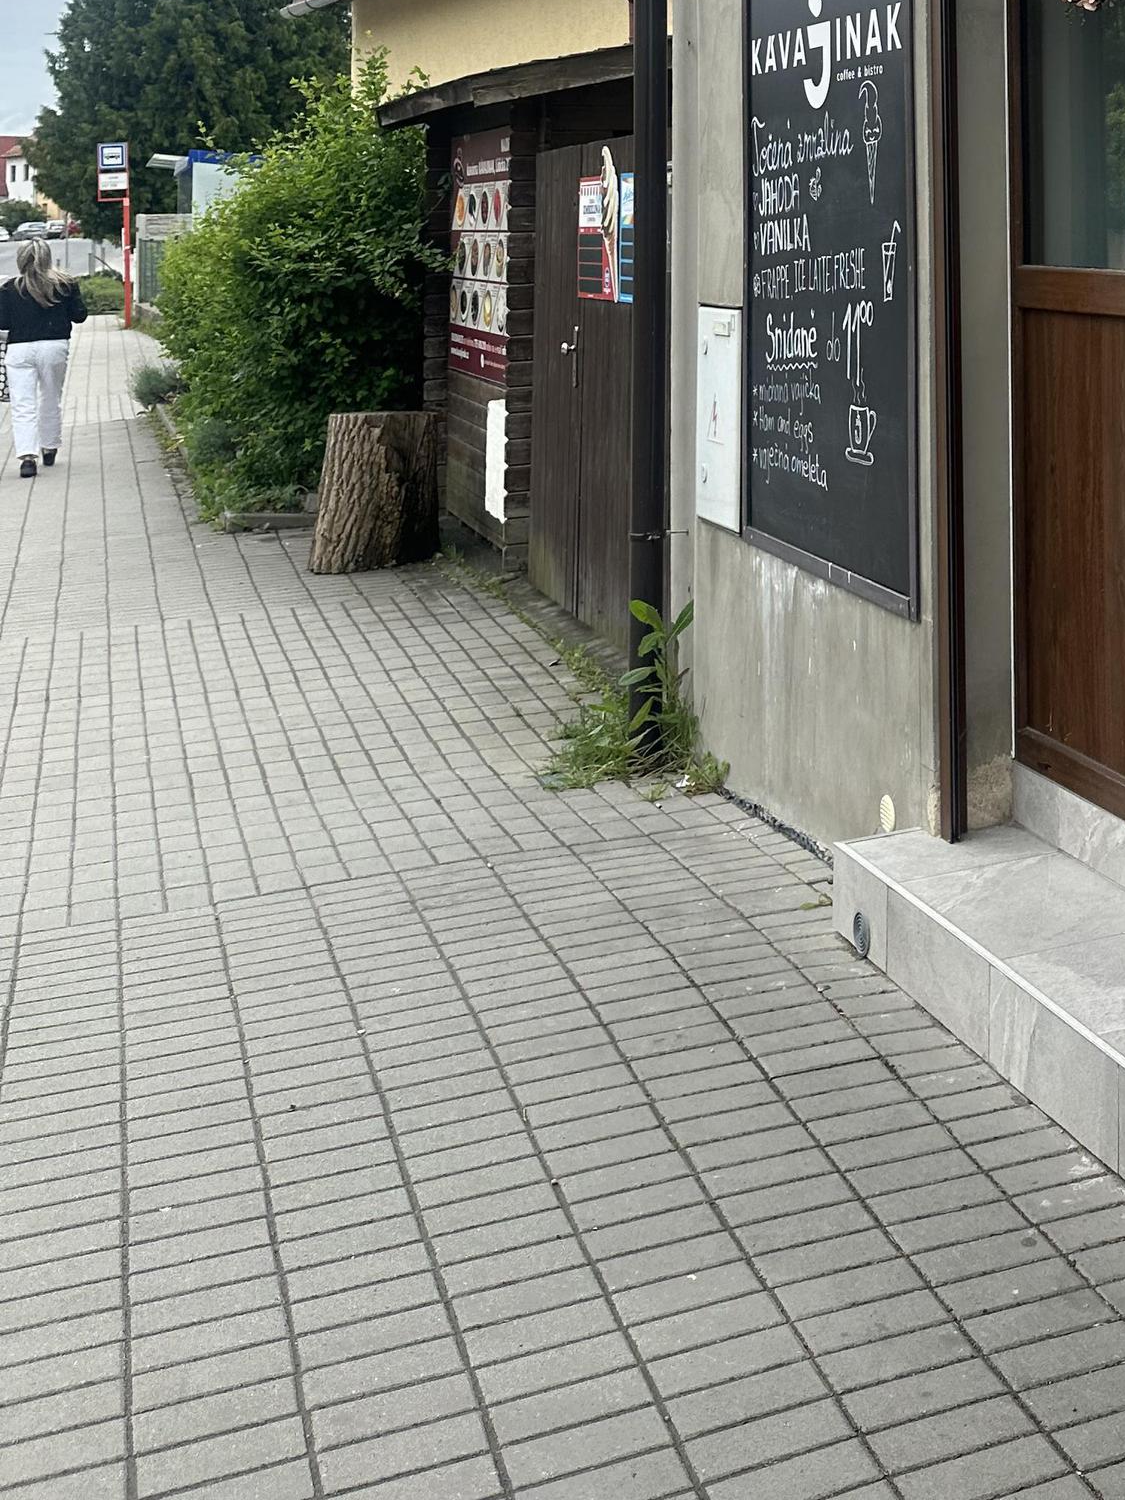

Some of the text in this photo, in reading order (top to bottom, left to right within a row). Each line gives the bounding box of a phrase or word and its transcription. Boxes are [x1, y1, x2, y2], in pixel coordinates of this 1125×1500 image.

[836, 64, 883, 82] coffee & bistro
[758, 173, 800, 217] JAHODA
[760, 214, 811, 256] VANILKA
[793, 259, 806, 293] ICE
[826, 311, 841, 362] do
[759, 405, 814, 455] Ham and eggs
[790, 453, 829, 492] omeleta
